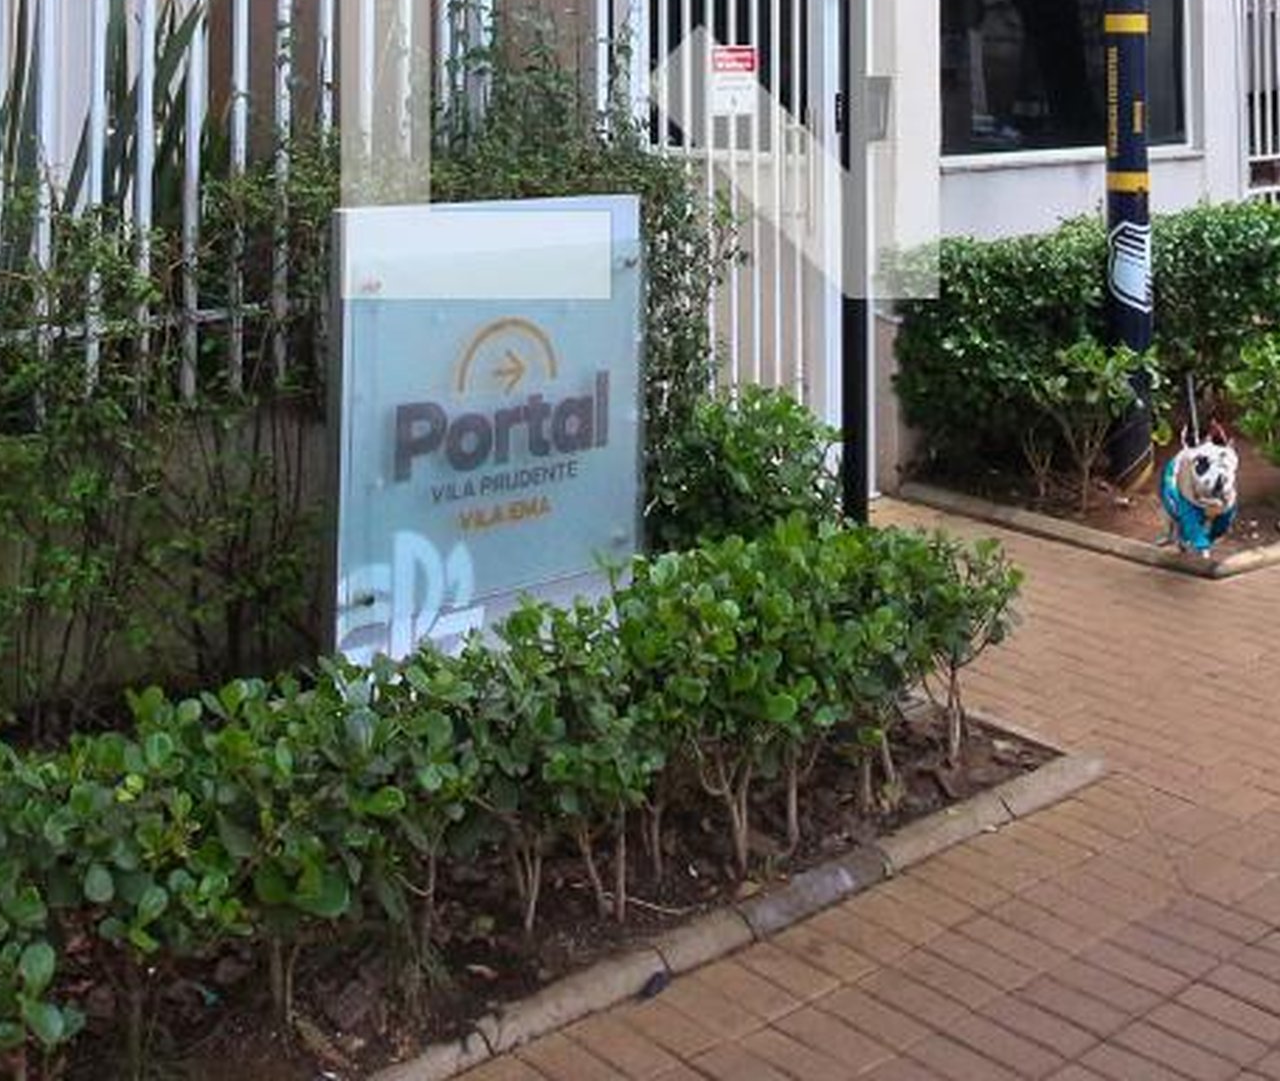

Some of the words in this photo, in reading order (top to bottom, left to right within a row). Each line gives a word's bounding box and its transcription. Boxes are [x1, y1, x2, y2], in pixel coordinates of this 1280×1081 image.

[394, 371, 609, 482] Portal
[431, 479, 475, 501] VILA
[480, 461, 578, 496] PRUDENTE
